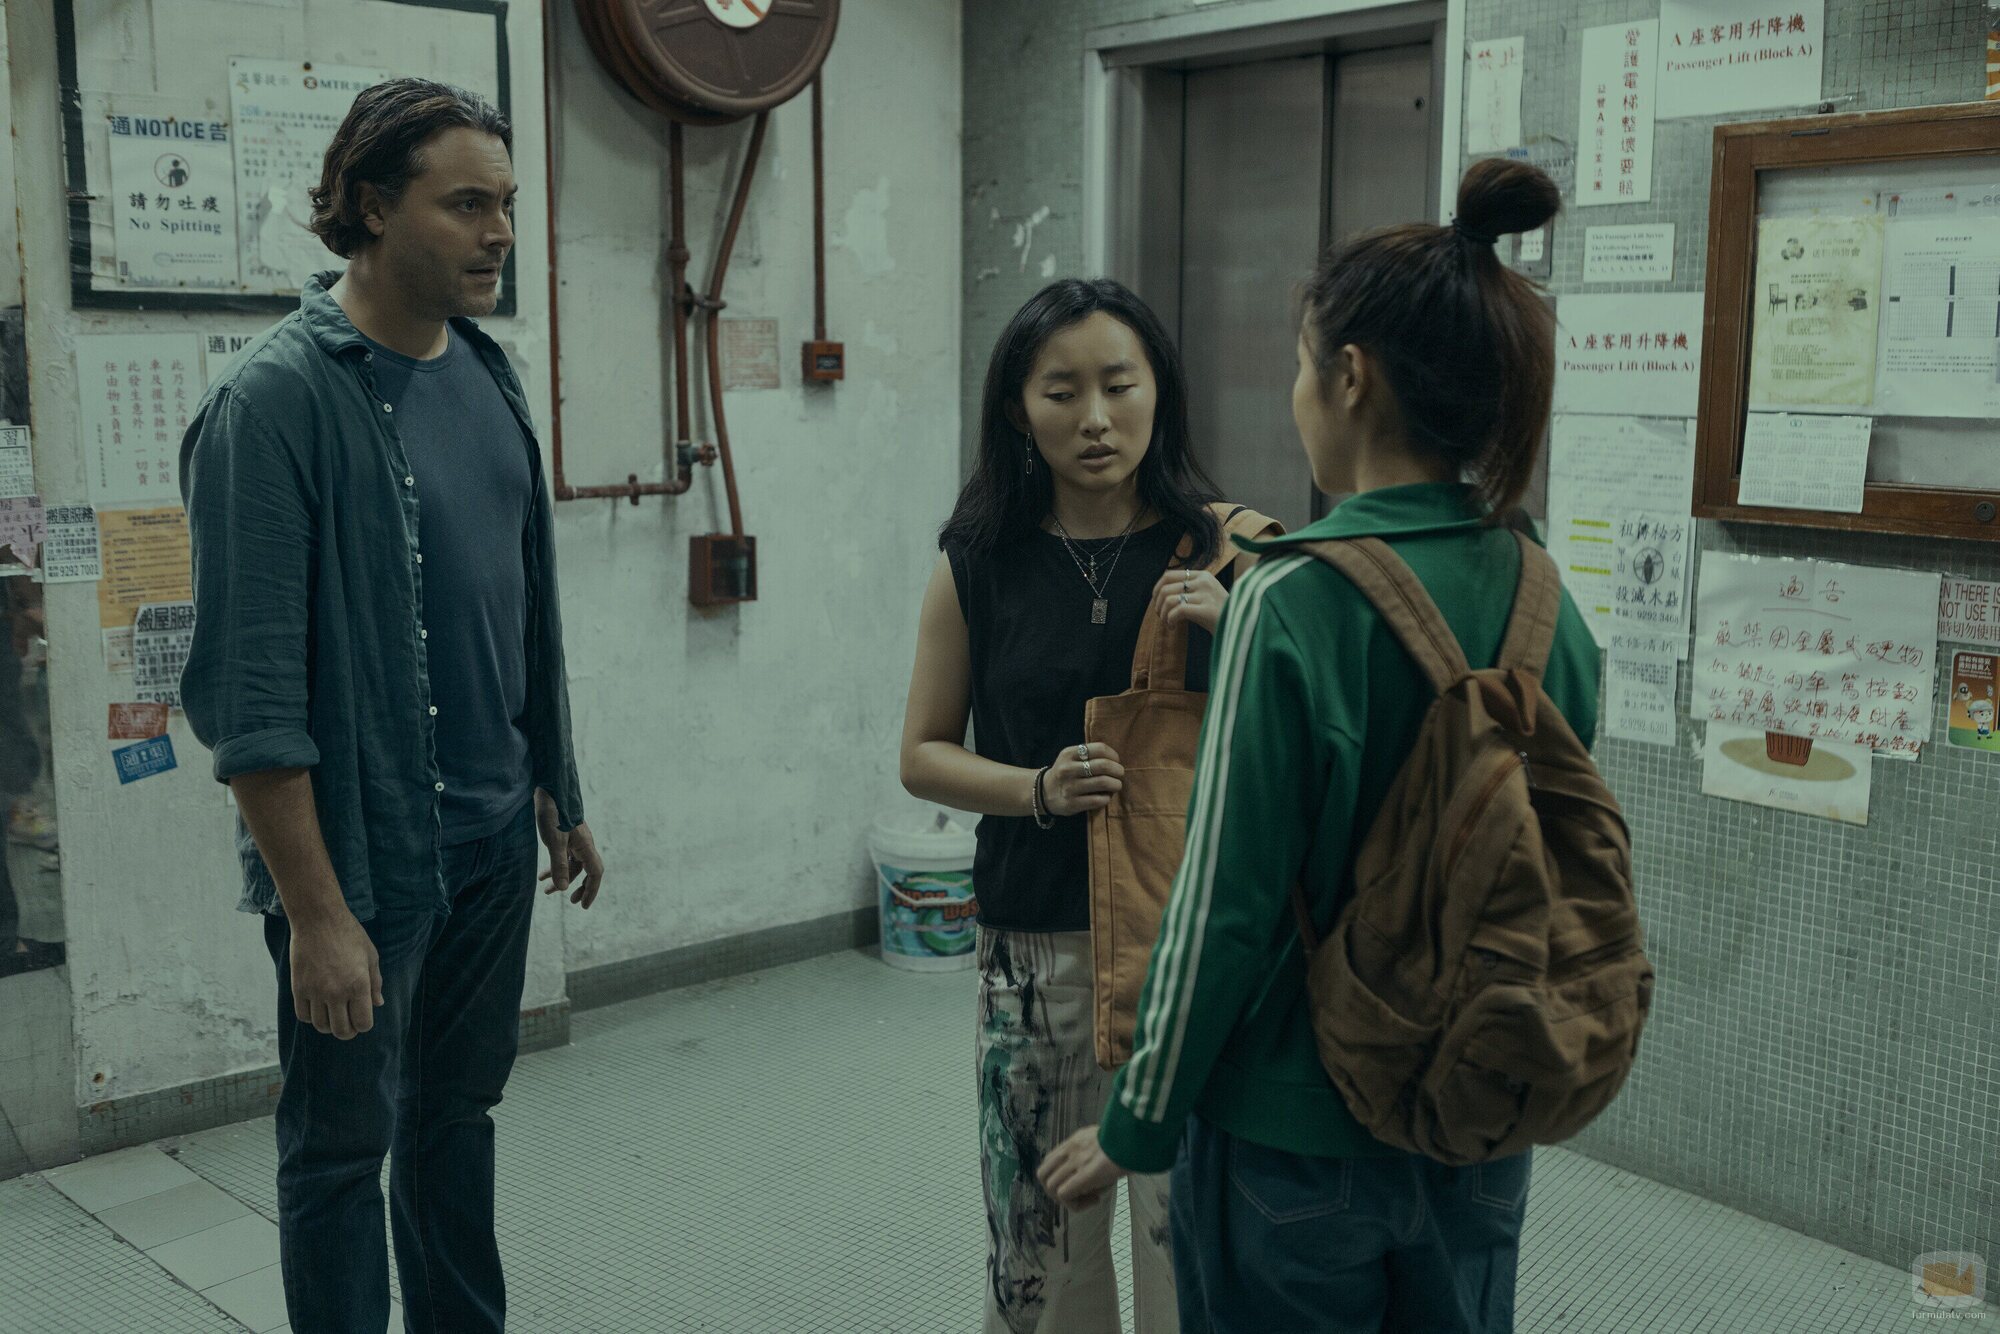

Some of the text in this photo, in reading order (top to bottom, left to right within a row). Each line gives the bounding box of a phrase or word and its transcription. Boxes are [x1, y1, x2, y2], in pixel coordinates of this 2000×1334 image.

[1666, 43, 1813, 72] Passenger Lift (Block A)
[320, 79, 350, 91] MTR
[111, 116, 131, 136] 通
[135, 118, 205, 139] NOTICE
[209, 122, 227, 141] 告
[129, 192, 221, 213] 請勿吐痰
[130, 217, 222, 235] No Spitting
[1563, 360, 1695, 374] Passenger Lift (Block A)
[46, 505, 95, 525] 搬屋服務
[59, 564, 79, 577] 9292
[1778, 575, 1846, 602] 通告
[1955, 583, 1990, 603] THERE
[1940, 601, 1960, 619] NOT
[1965, 603, 1987, 621] USE
